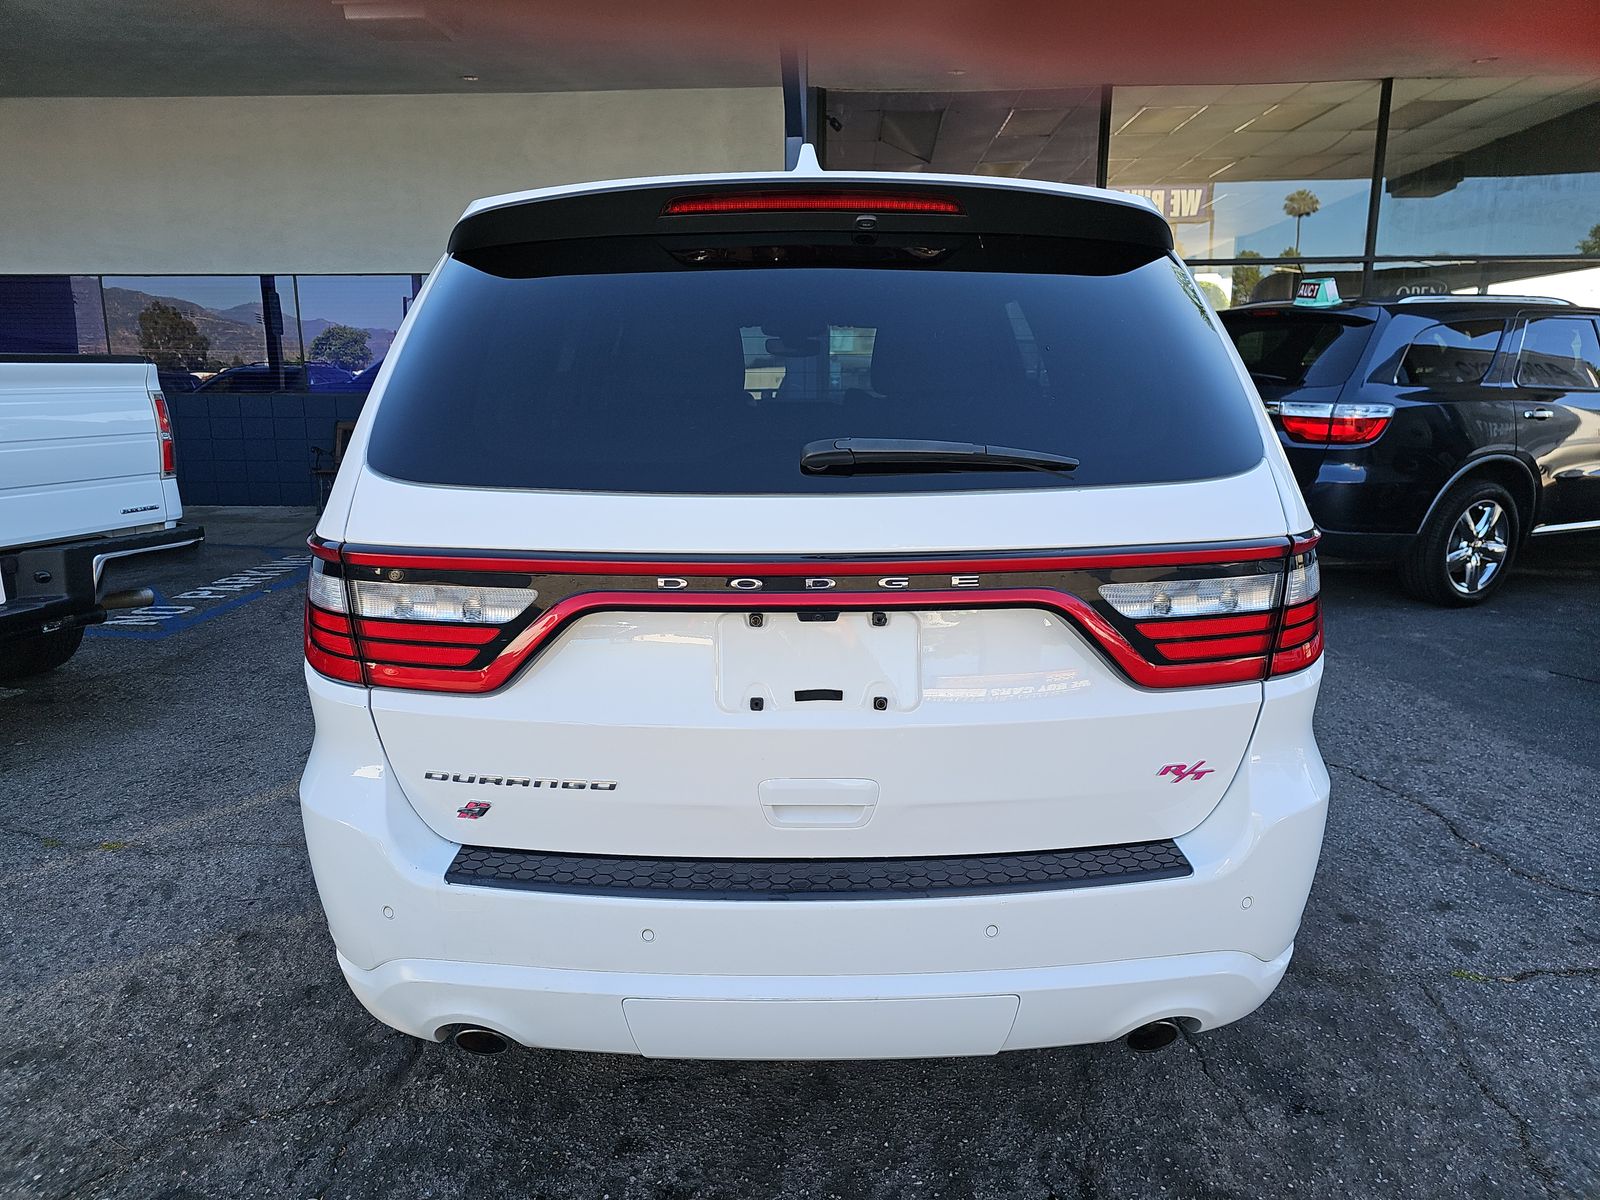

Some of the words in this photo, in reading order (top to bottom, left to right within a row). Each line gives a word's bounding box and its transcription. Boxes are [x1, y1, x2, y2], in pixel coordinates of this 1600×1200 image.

[657, 576, 980, 590] DODGE
[102, 605, 195, 625] NO
[424, 770, 618, 791] DURANGO
[1155, 760, 1216, 784] R/T
